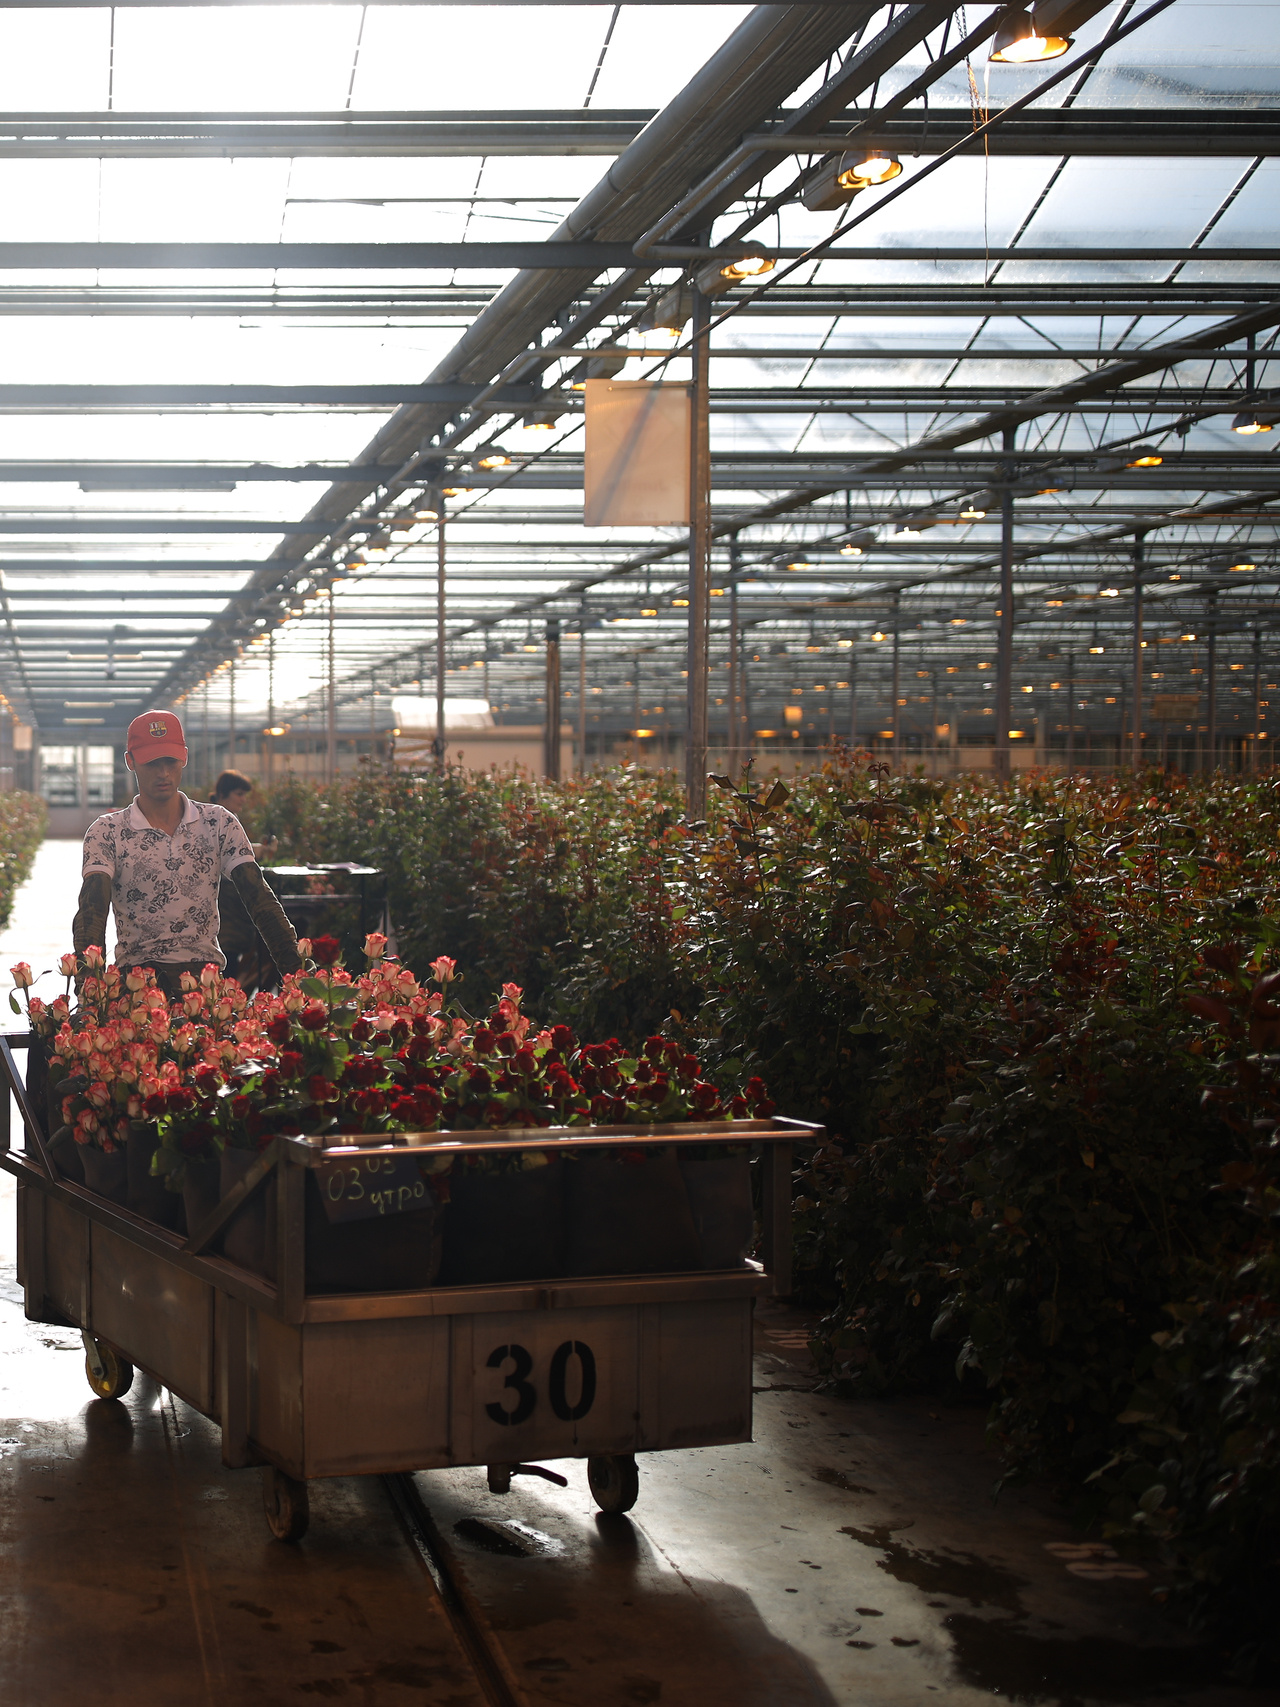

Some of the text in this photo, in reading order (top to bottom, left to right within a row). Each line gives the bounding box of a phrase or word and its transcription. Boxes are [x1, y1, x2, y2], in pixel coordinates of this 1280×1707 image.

[328, 1167, 425, 1214] 03 утро
[485, 1340, 597, 1426] 30
